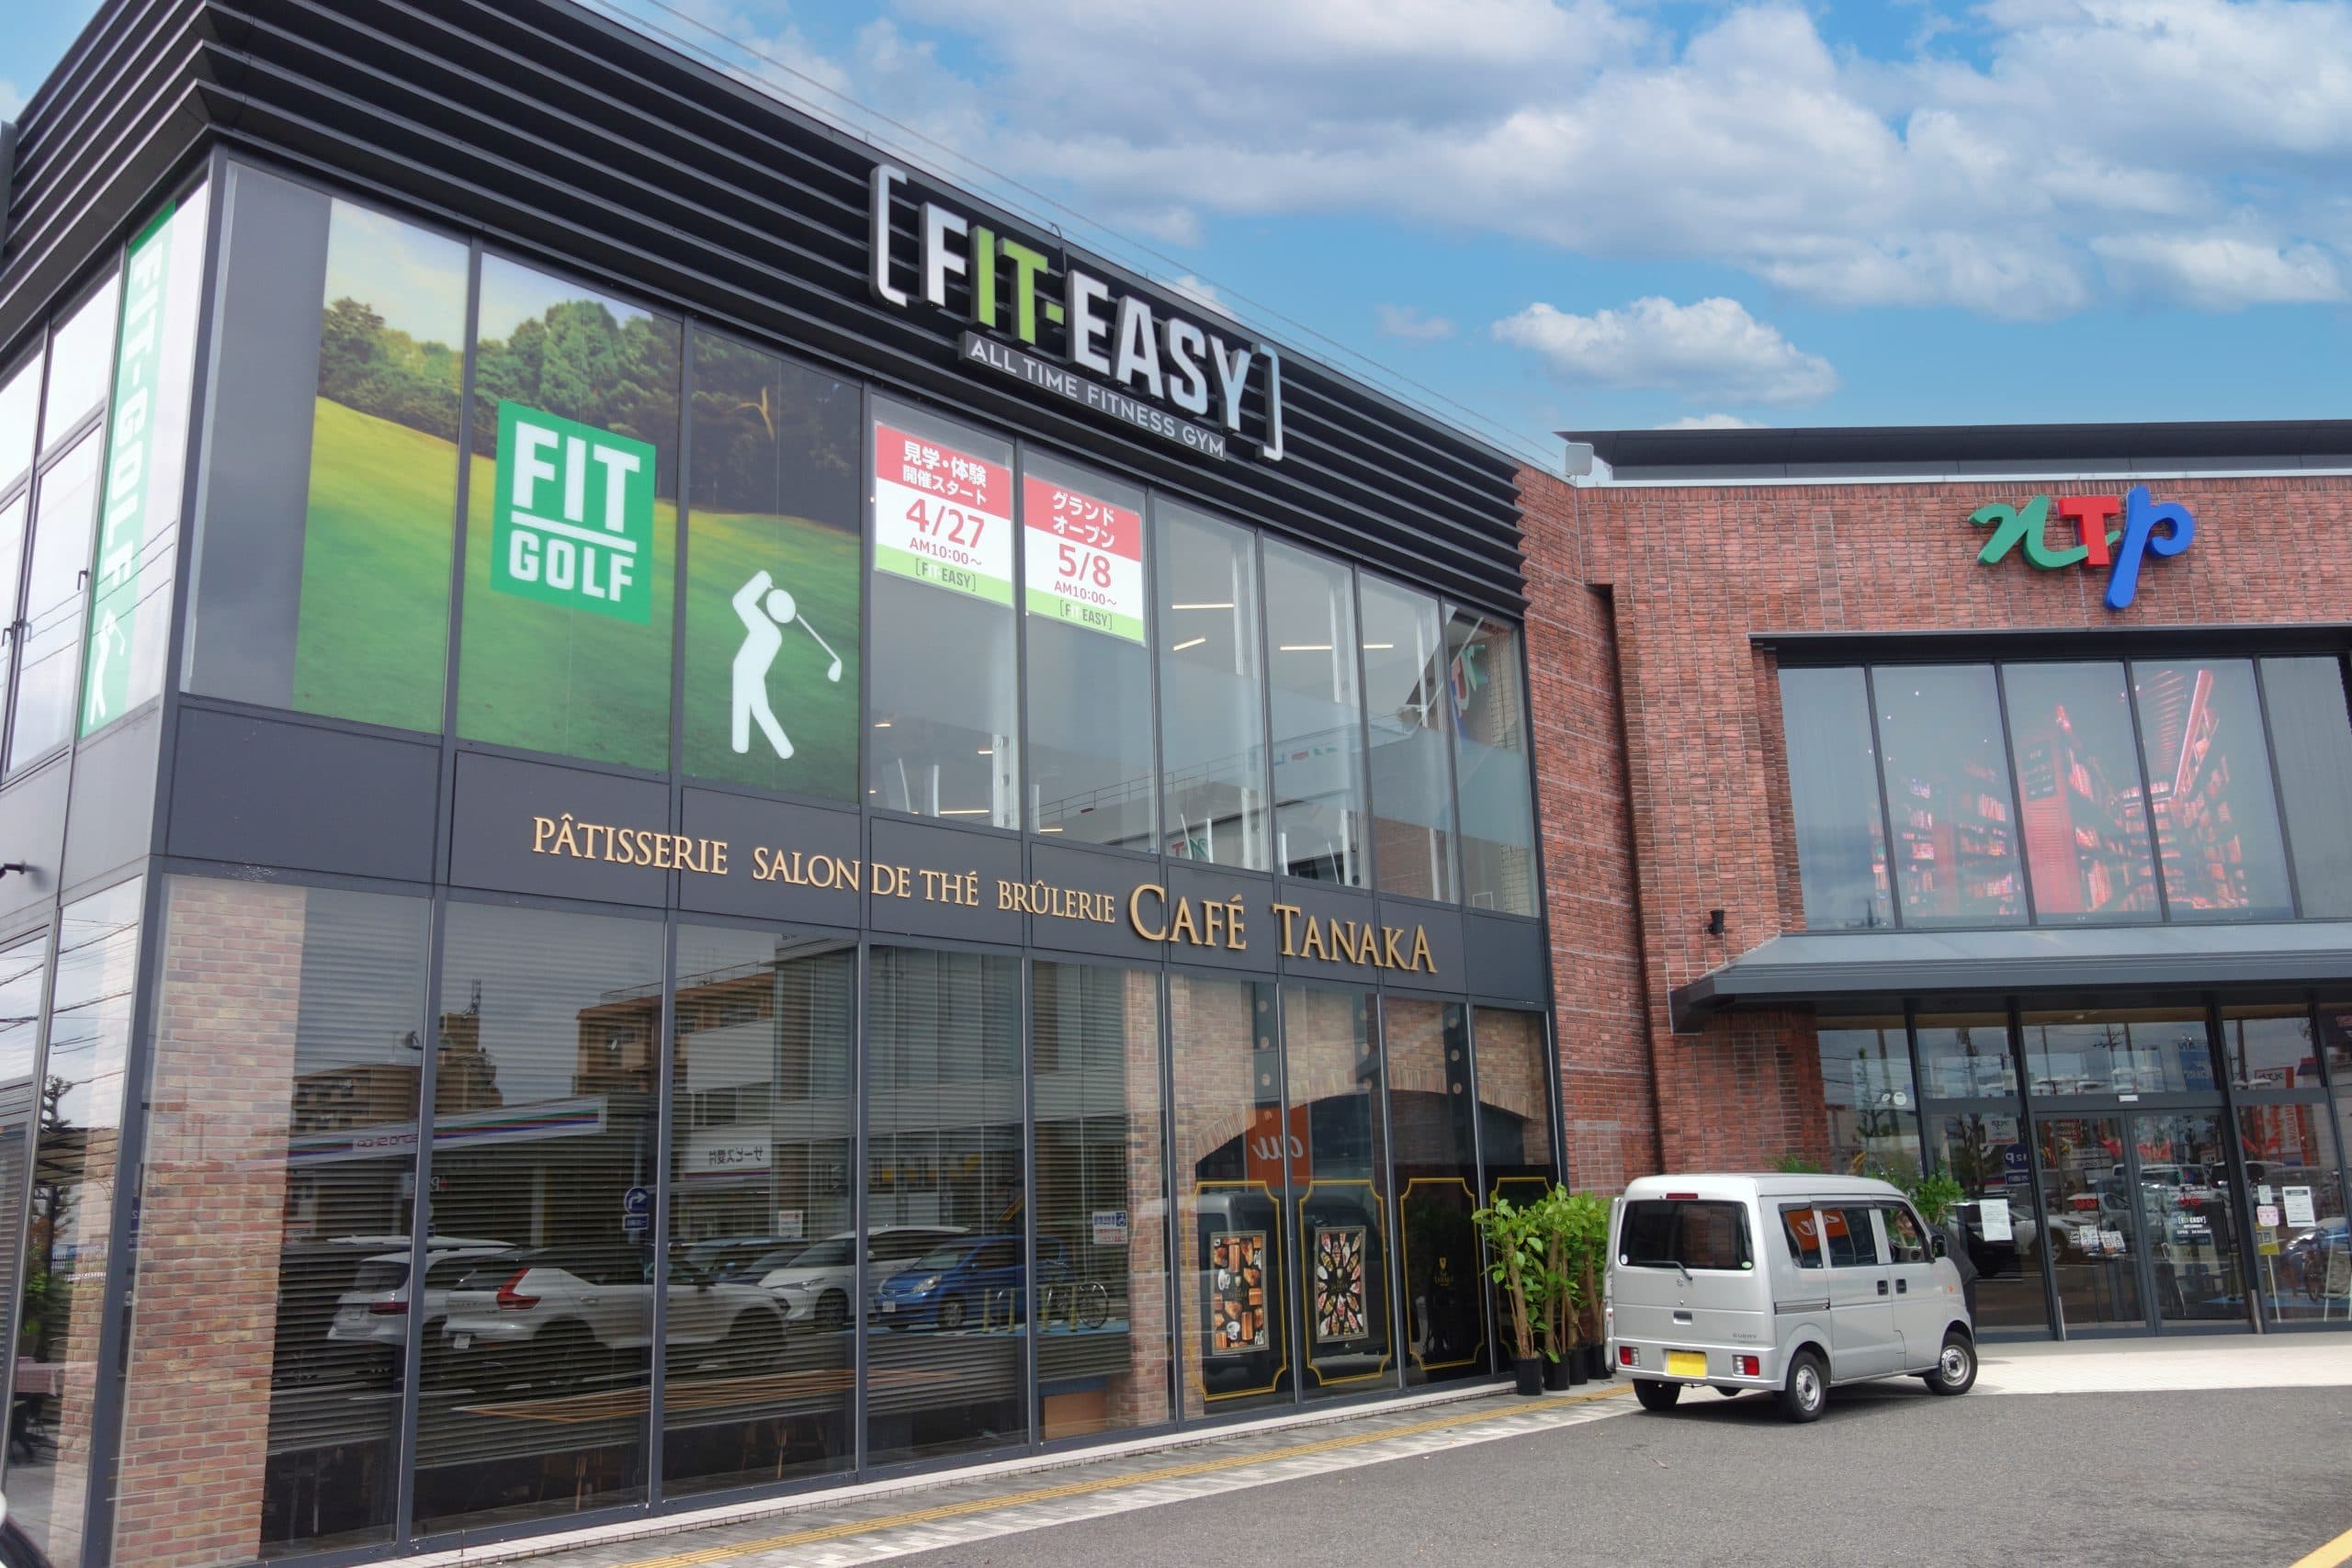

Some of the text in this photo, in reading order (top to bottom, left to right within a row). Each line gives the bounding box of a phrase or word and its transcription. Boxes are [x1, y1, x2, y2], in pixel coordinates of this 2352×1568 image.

[103, 241, 166, 592] FIT-GOLF
[970, 339, 1225, 457] ALL TIME FITNESS GYM
[511, 421, 641, 535] FIT
[903, 439, 987, 489] 見学・体験
[903, 464, 987, 505] 開催スタート
[905, 498, 985, 549] 4/27
[1052, 491, 1114, 526] グランド
[1052, 515, 1115, 548] オープン
[509, 531, 635, 603] GOLF
[1058, 543, 1112, 589] 5/8
[532, 813, 729, 875] PÂTISSERIE
[752, 847, 861, 892] SALON
[871, 863, 911, 898] DE
[919, 870, 979, 907] THÉ
[997, 879, 1116, 924] BRÛLERIE
[1272, 903, 1439, 974] TANAKA
